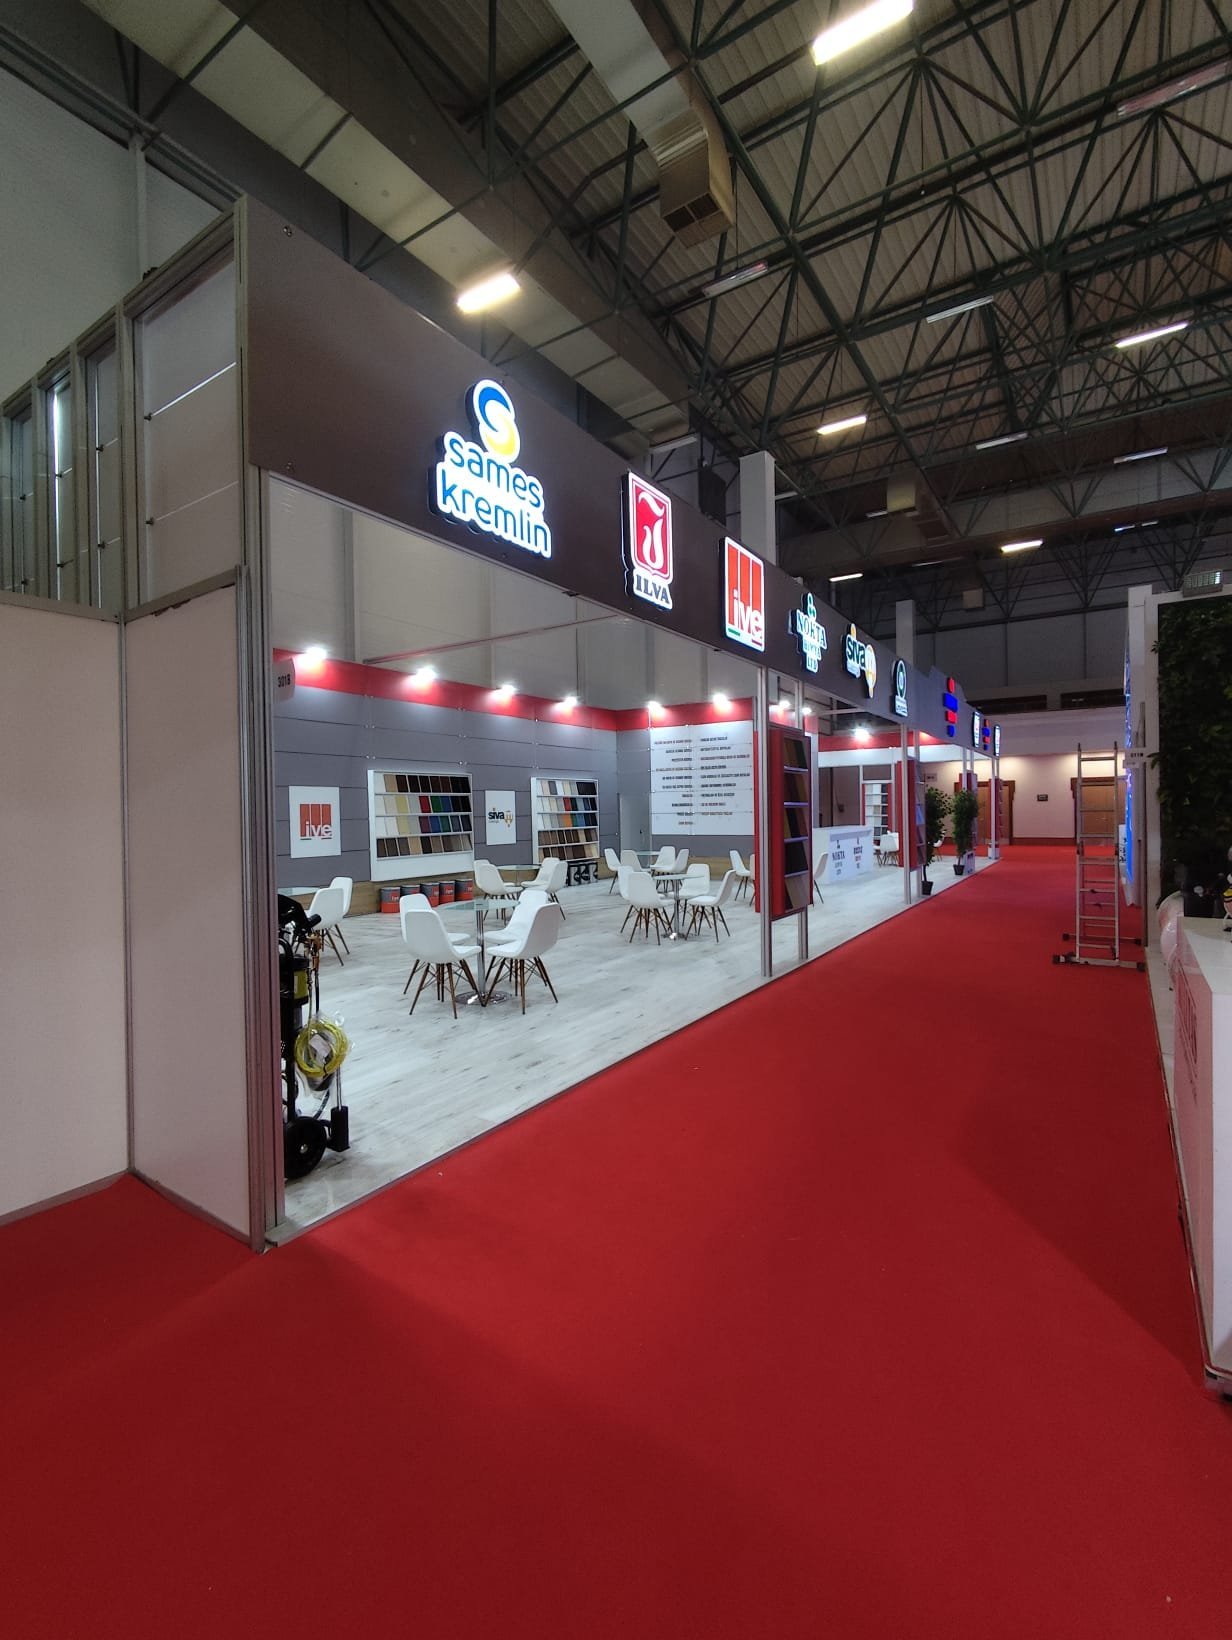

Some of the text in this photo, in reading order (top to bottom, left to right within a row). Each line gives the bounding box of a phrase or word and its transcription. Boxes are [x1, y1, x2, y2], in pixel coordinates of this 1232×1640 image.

[448, 435, 542, 507] sames
[441, 468, 549, 553] kremlin
[635, 573, 670, 604] ILVA
